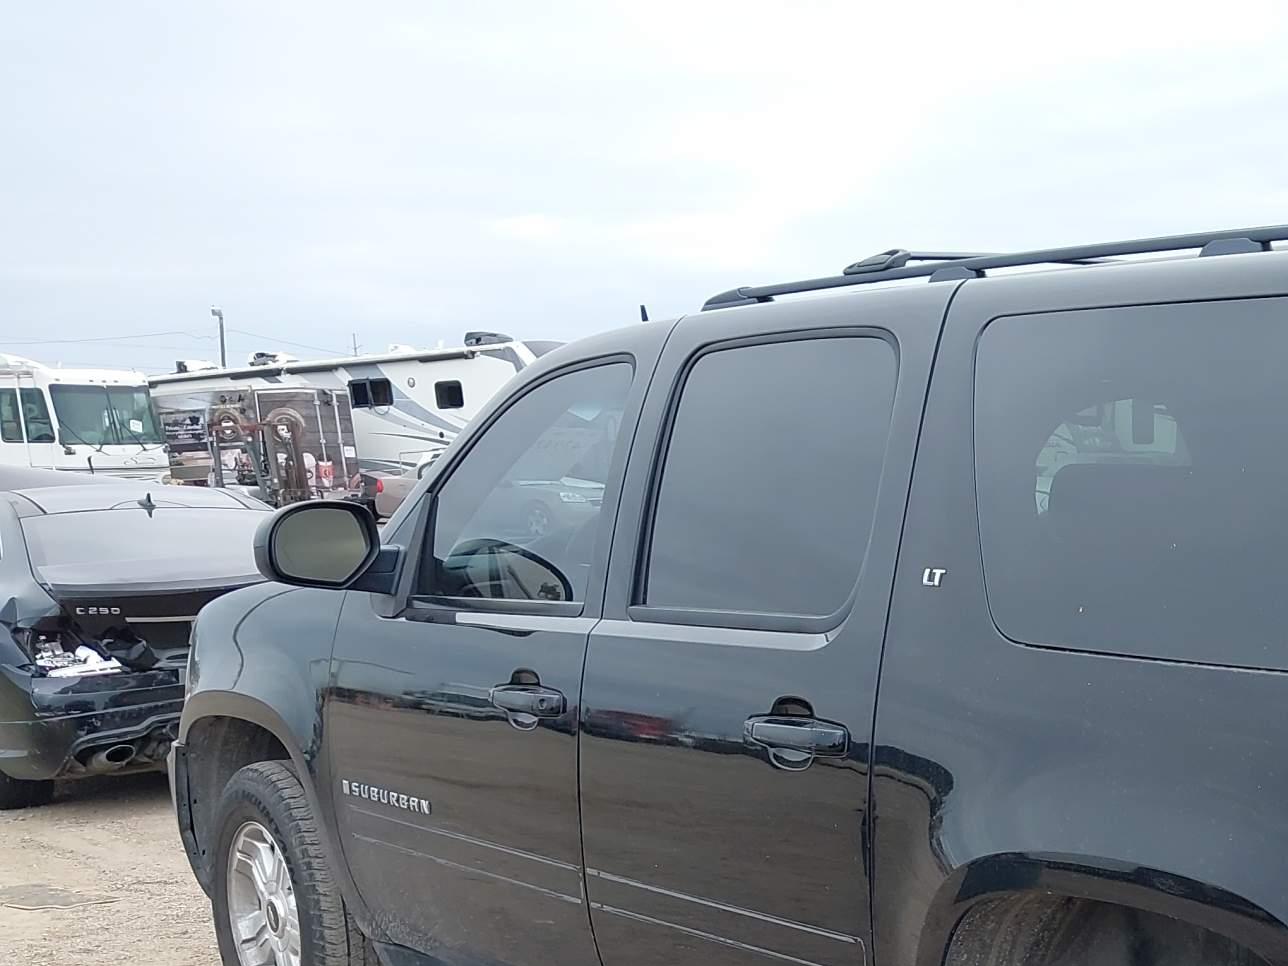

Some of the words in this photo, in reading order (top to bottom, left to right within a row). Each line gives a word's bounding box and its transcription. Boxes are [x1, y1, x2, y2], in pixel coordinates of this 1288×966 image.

[922, 568, 946, 587] LT
[75, 607, 86, 615] C
[88, 606, 121, 615] 250
[351, 782, 431, 815] SUBURBAN
